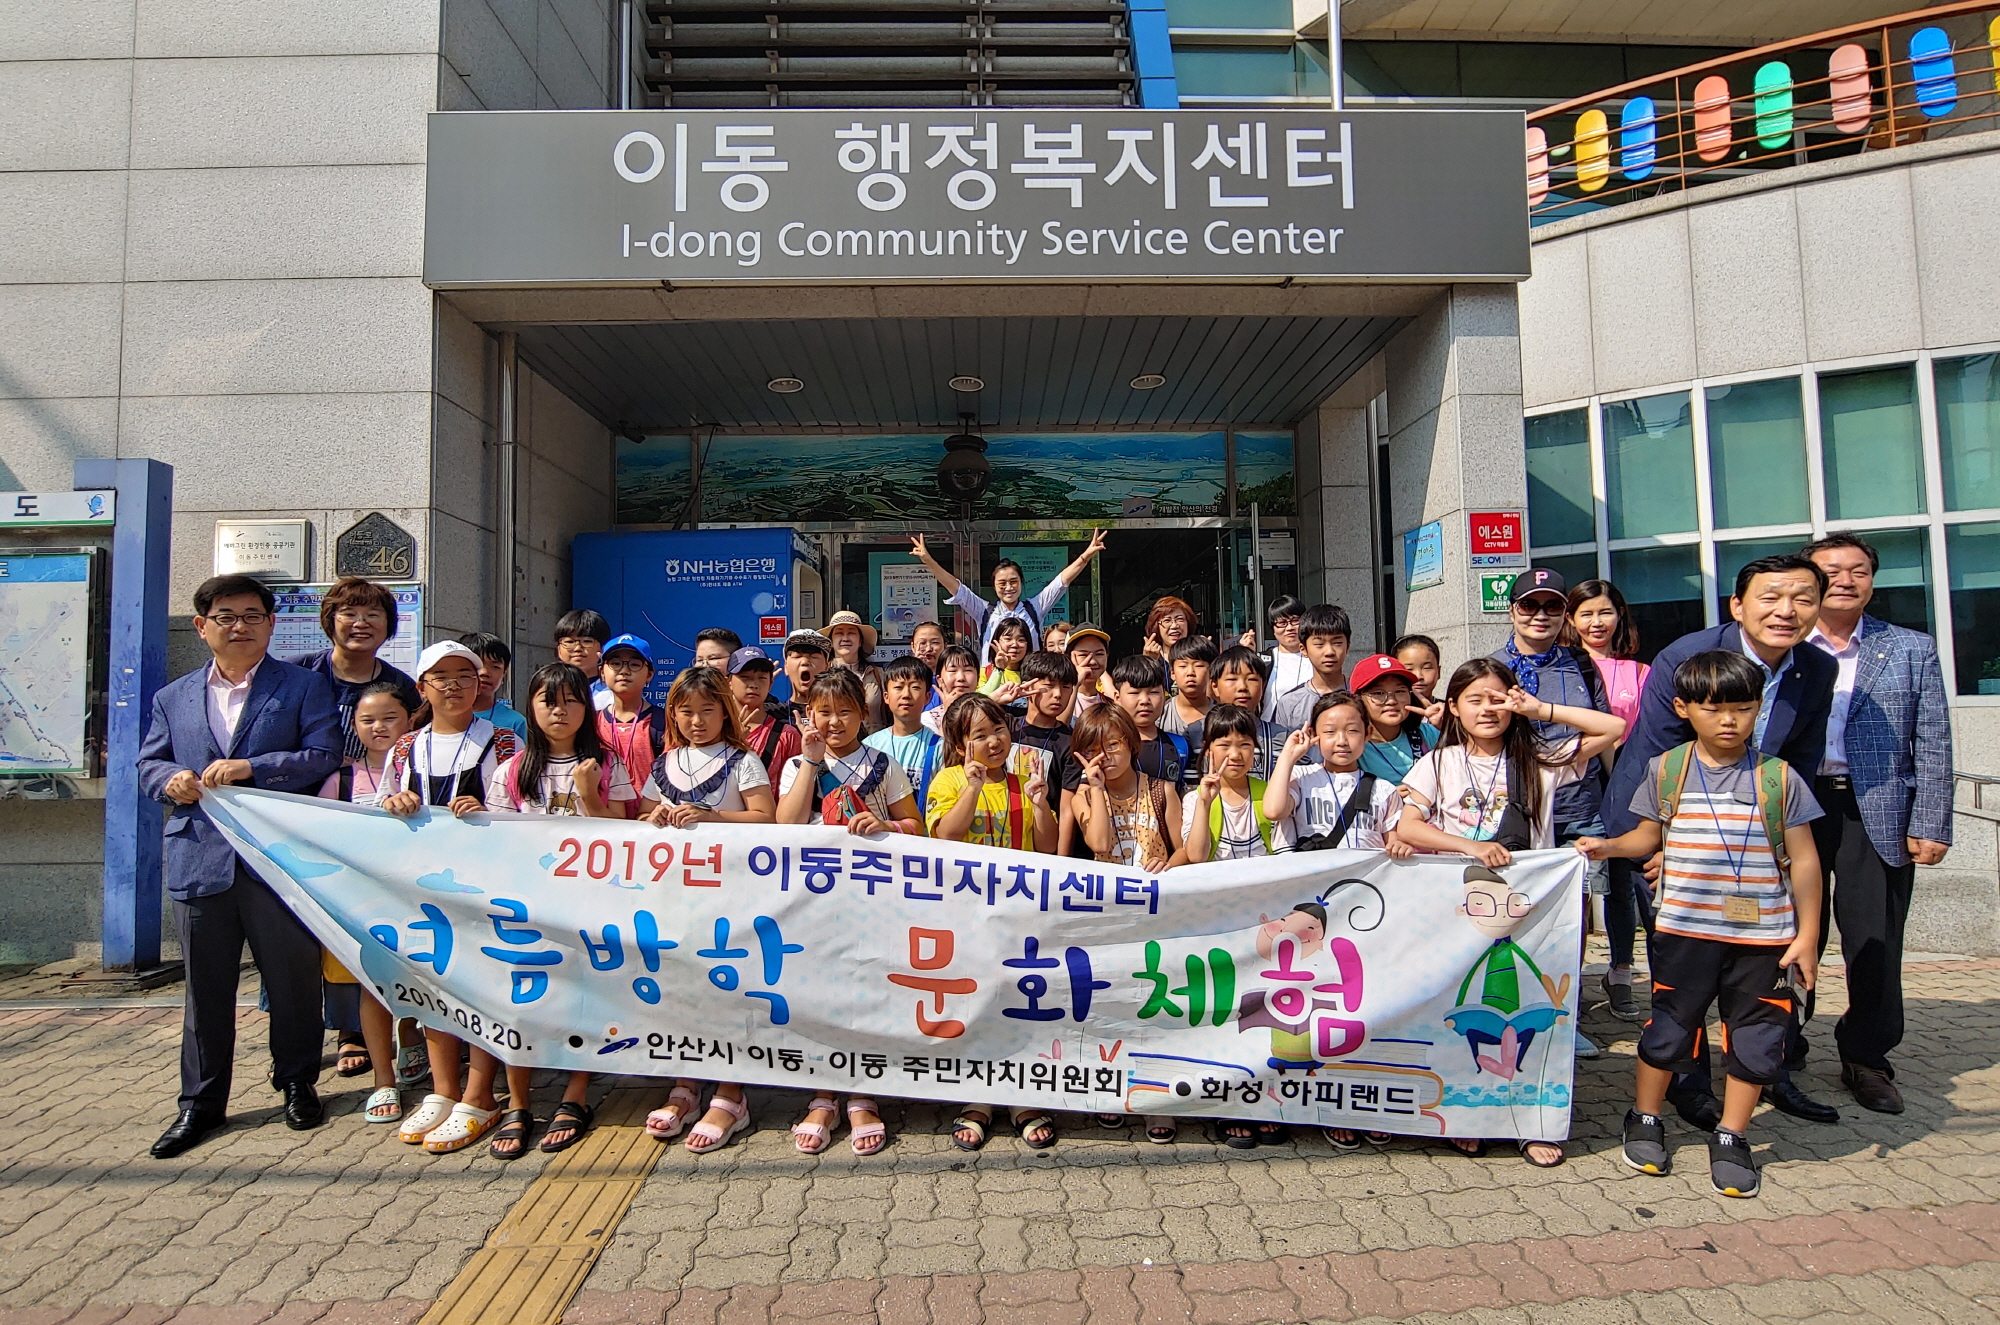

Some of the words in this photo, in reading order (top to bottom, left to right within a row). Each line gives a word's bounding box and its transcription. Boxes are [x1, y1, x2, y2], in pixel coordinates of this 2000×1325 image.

[613, 125, 789, 210] 이동
[834, 122, 1355, 210] 행정복지센터
[621, 221, 763, 268] I-dong
[777, 221, 1028, 268] Community
[1041, 219, 1190, 257] Service
[1203, 219, 1344, 257] Center
[14, 495, 40, 517] 도
[1478, 525, 1513, 539] 에스원
[369, 546, 409, 574] 46
[683, 558, 776, 574] NH농협은행
[1535, 571, 1549, 585] P
[1378, 657, 1392, 669] S
[553, 837, 723, 887] 2019년
[748, 845, 1159, 915] 이동주민자치센터
[369, 898, 805, 1025] 여름방학
[887, 926, 1366, 1058] 문화체험
[646, 1032, 734, 1065] 안산시
[747, 1045, 816, 1076] 이동,
[828, 1051, 889, 1078] 이동
[903, 1056, 1123, 1097] 주민자치위원회
[1200, 1076, 1265, 1102] 화성
[1280, 1079, 1415, 1115] 하피랜드
